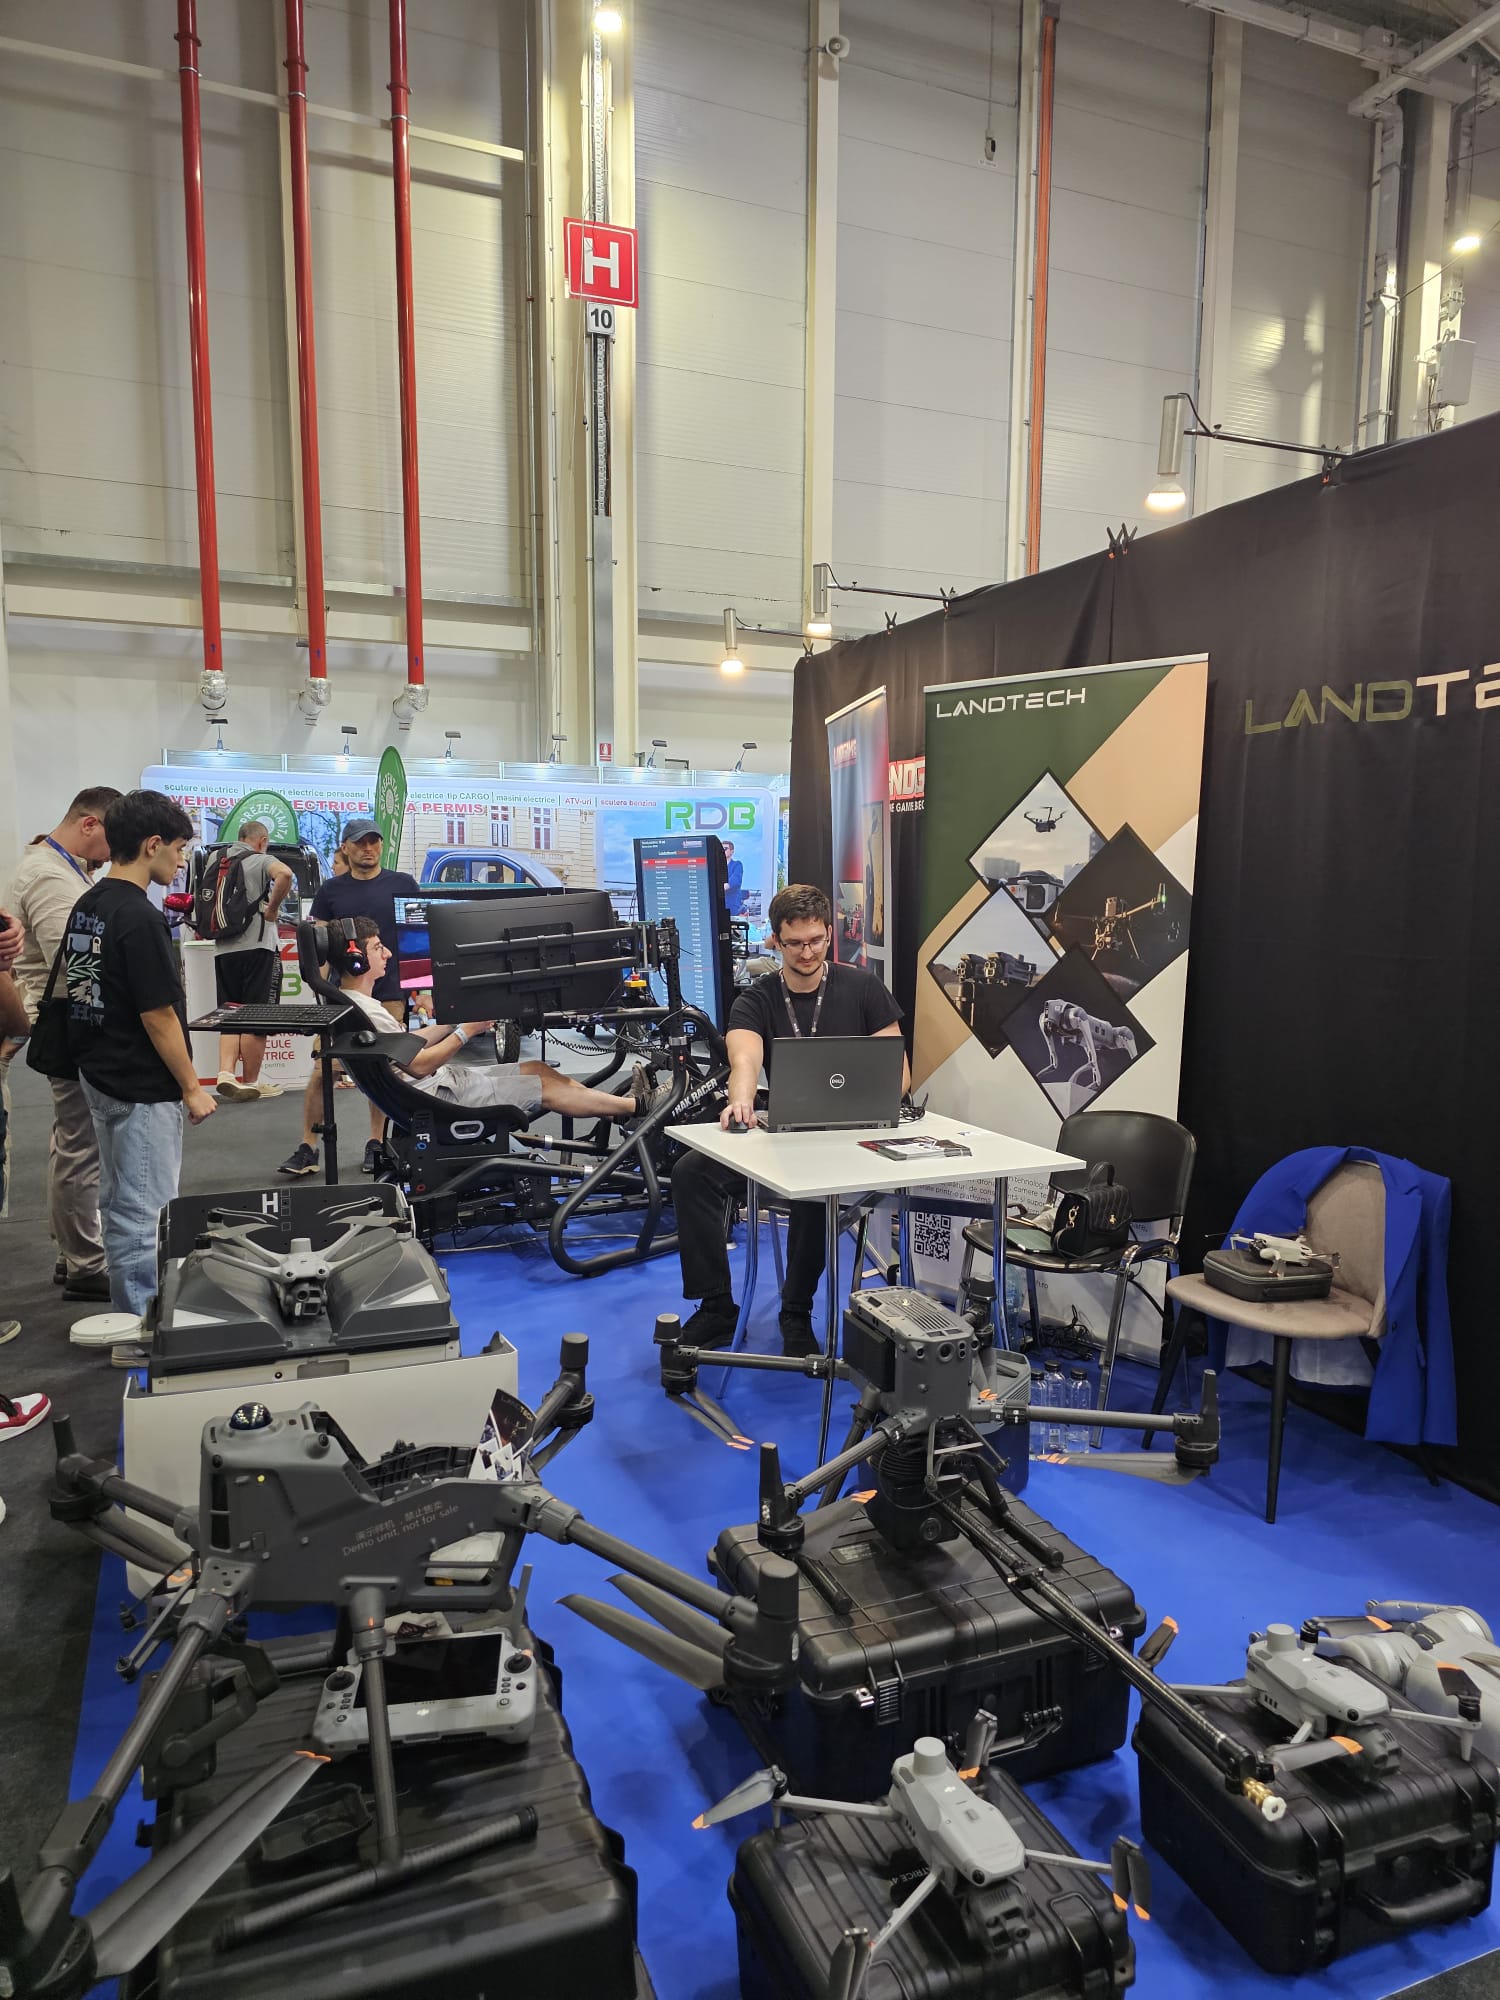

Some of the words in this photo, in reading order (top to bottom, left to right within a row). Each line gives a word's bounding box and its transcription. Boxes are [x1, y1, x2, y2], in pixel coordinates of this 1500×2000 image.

[583, 236, 620, 289] H
[590, 308, 613, 329] 10
[935, 687, 1087, 718] LANDTECH
[169, 795, 240, 809] VEHICU
[293, 799, 369, 812] ECTRICE
[422, 802, 484, 814] PERMIS
[459, 792, 490, 801] CARGO
[665, 800, 756, 831] RDB
[690, 1078, 718, 1102] RACER
[261, 1191, 279, 1214] H
[341, 1538, 375, 1556] Demo
[402, 1517, 421, 1534] not
[421, 1512, 437, 1526] for
[438, 1503, 460, 1519] sale
